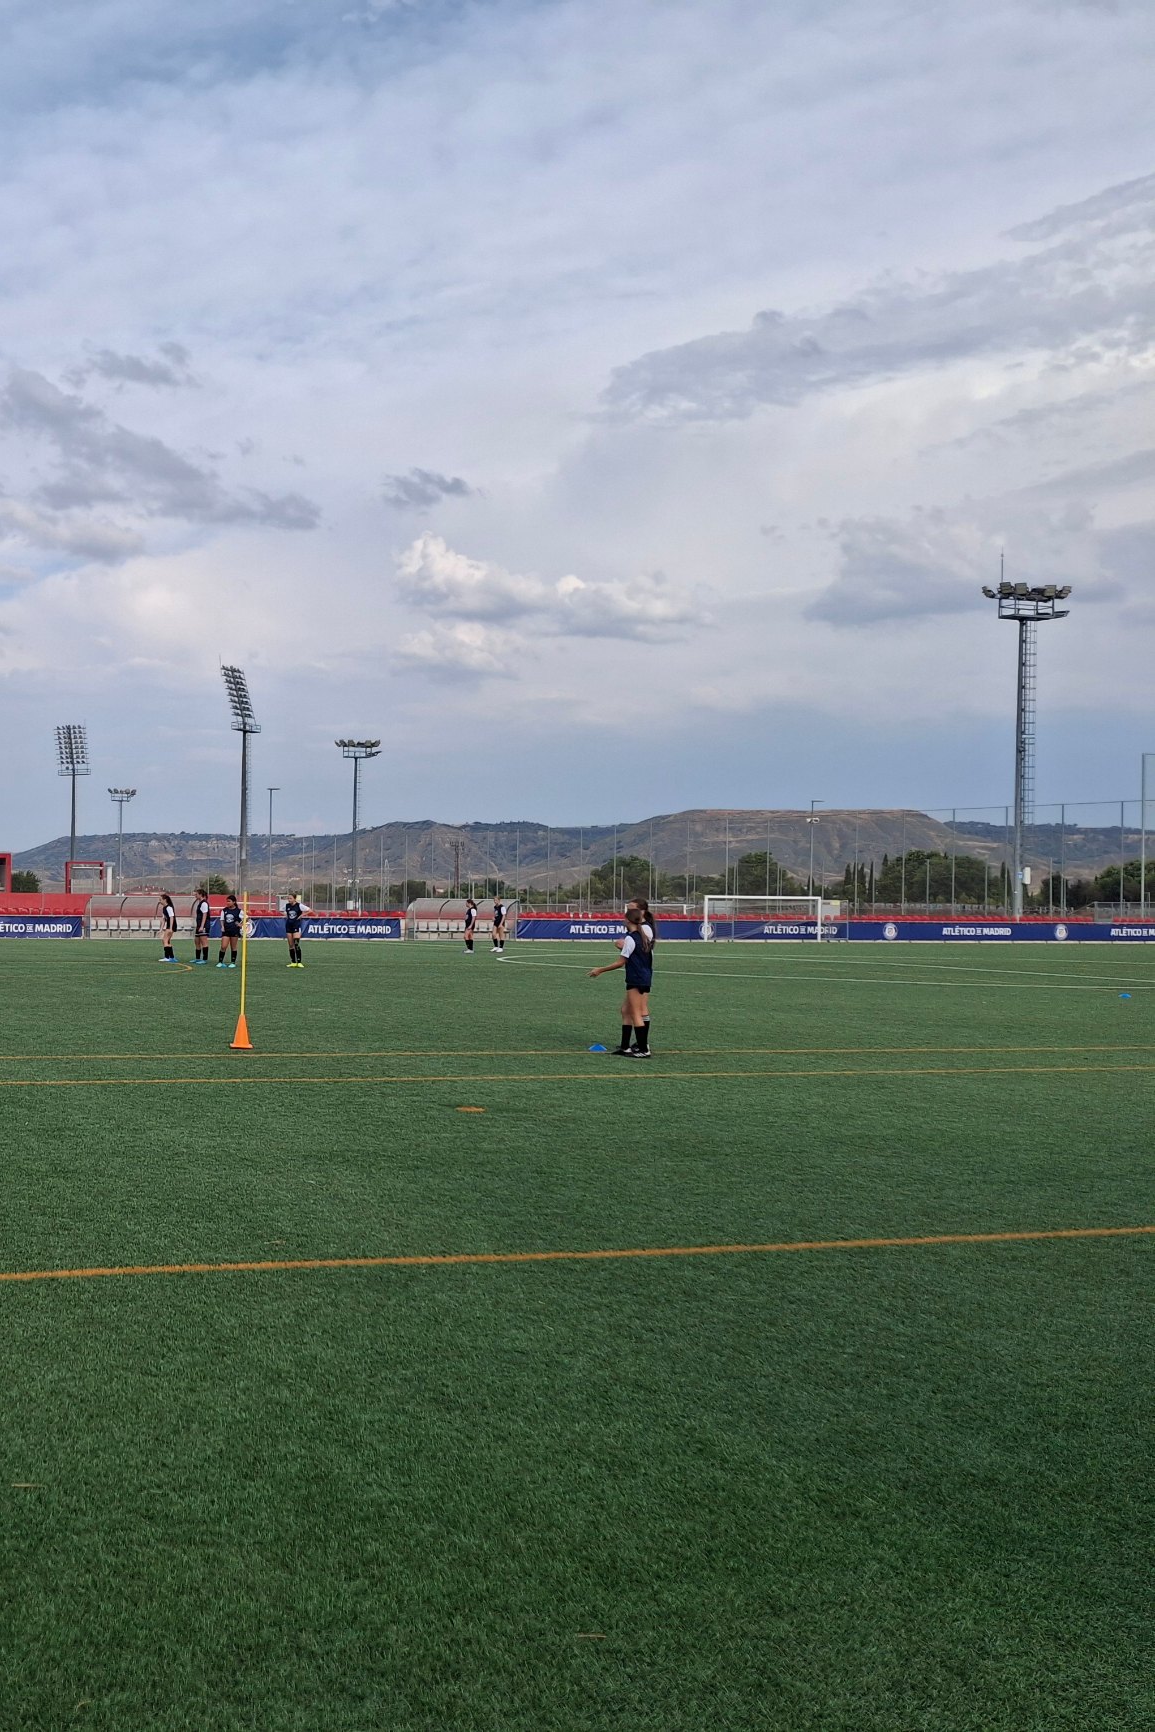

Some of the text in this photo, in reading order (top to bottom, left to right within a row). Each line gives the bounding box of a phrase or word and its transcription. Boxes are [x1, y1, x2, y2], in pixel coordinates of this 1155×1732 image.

[35, 923, 72, 933] MADRID
[308, 923, 348, 934] ATLÉTICO
[356, 925, 392, 934] MADRID
[570, 924, 608, 934] ATLÉTICO
[764, 924, 799, 934] ATLÉTICO
[942, 925, 975, 936] ATLÉTICO
[983, 927, 1012, 936] MADRID
